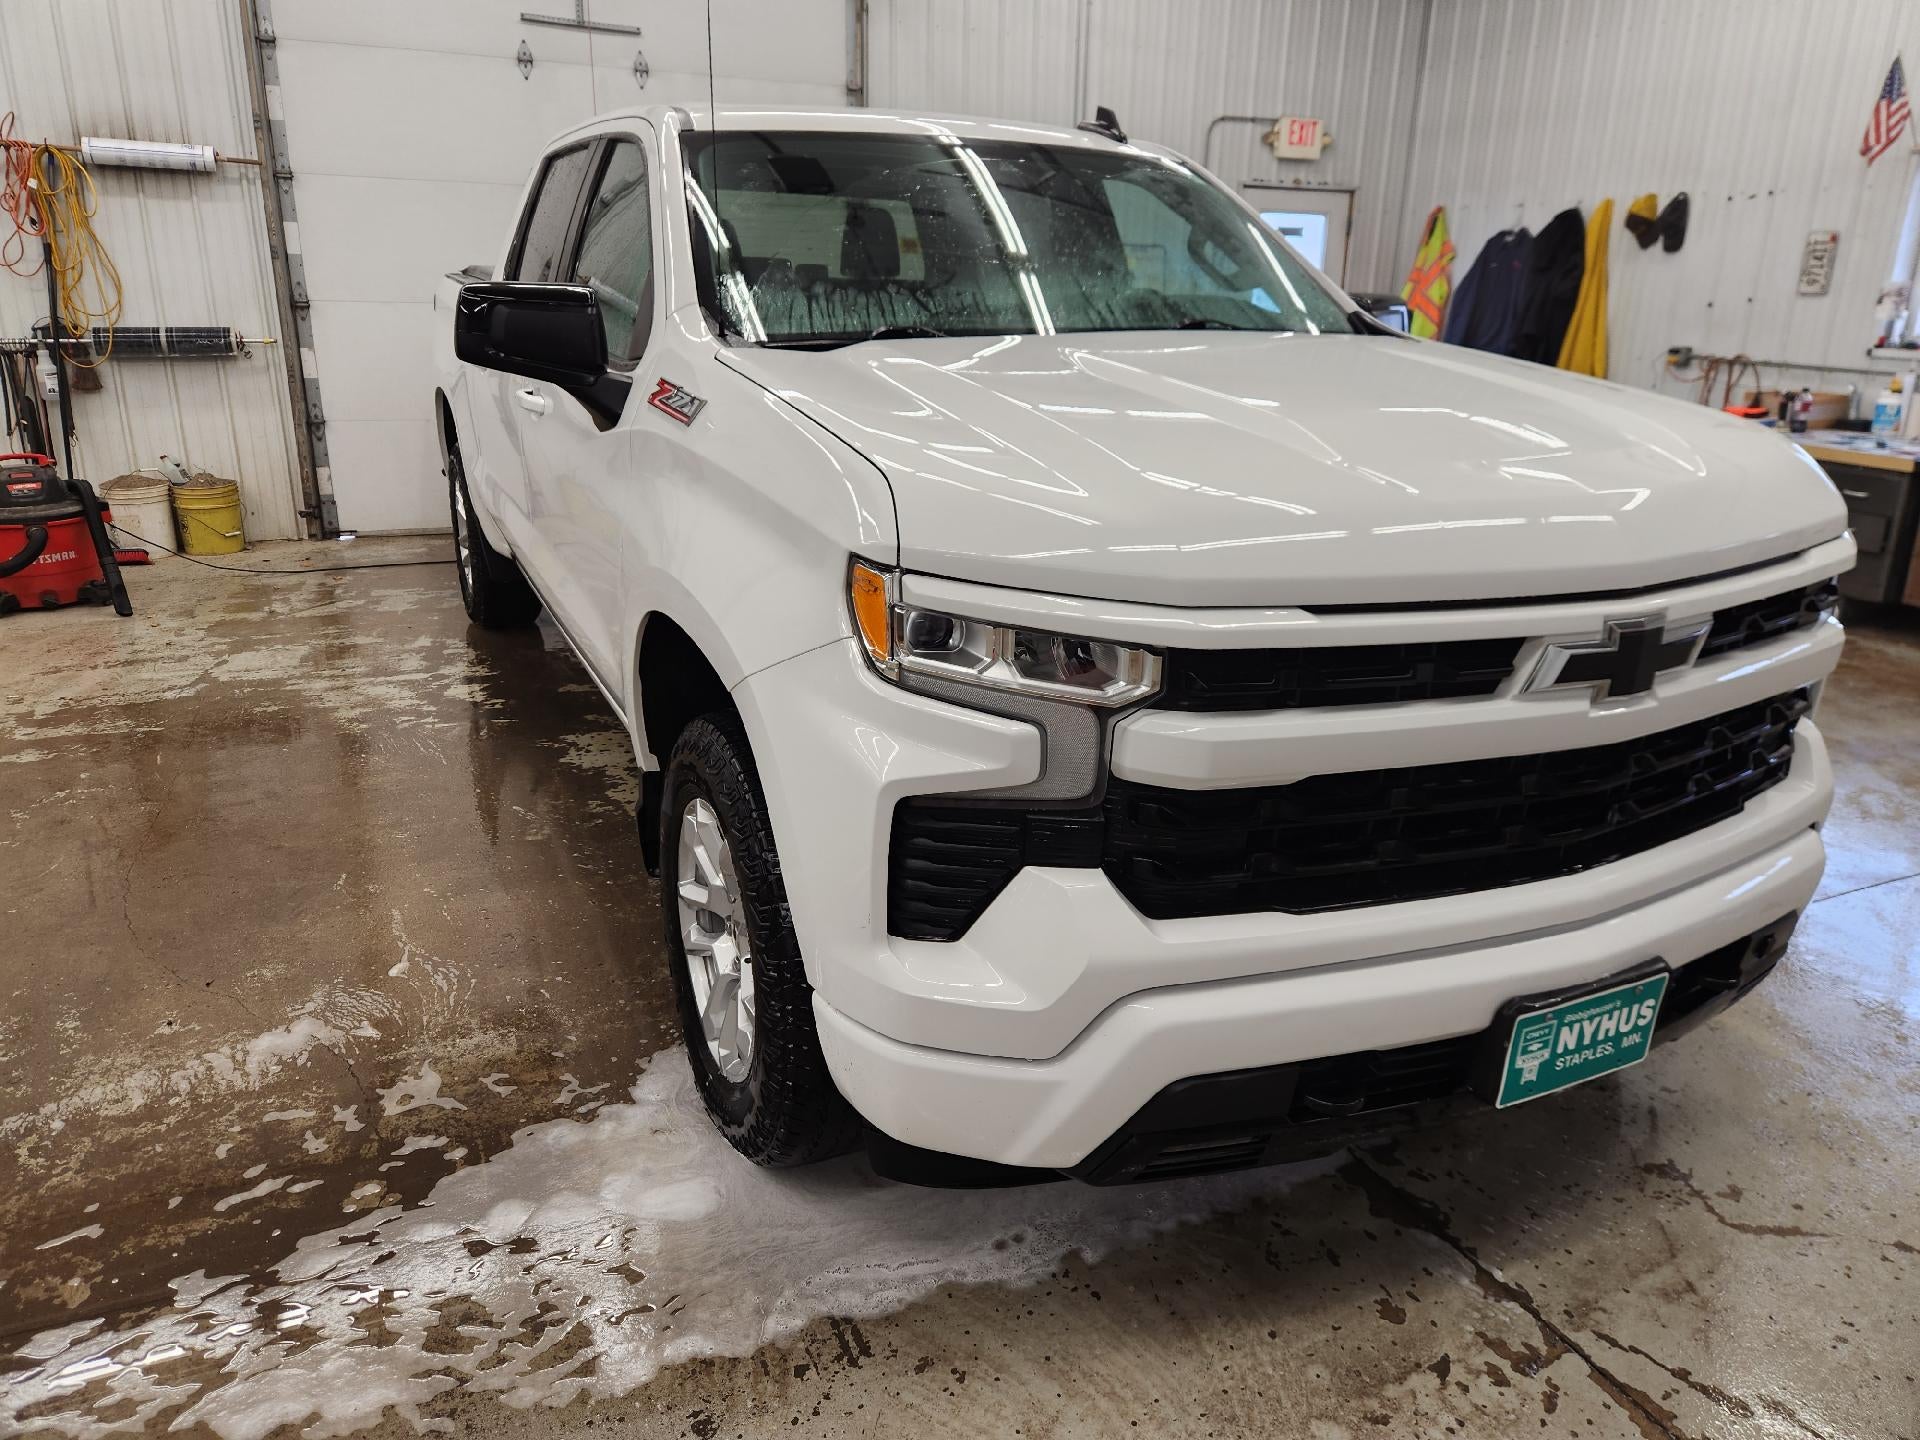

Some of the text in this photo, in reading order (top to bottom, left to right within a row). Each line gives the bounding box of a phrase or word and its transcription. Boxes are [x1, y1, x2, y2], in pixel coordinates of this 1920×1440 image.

[1288, 119, 1318, 147] EXIT
[647, 376, 708, 427] Z71
[1556, 998, 1656, 1055] NYHUS
[1555, 1042, 1615, 1071] STAPLES,
